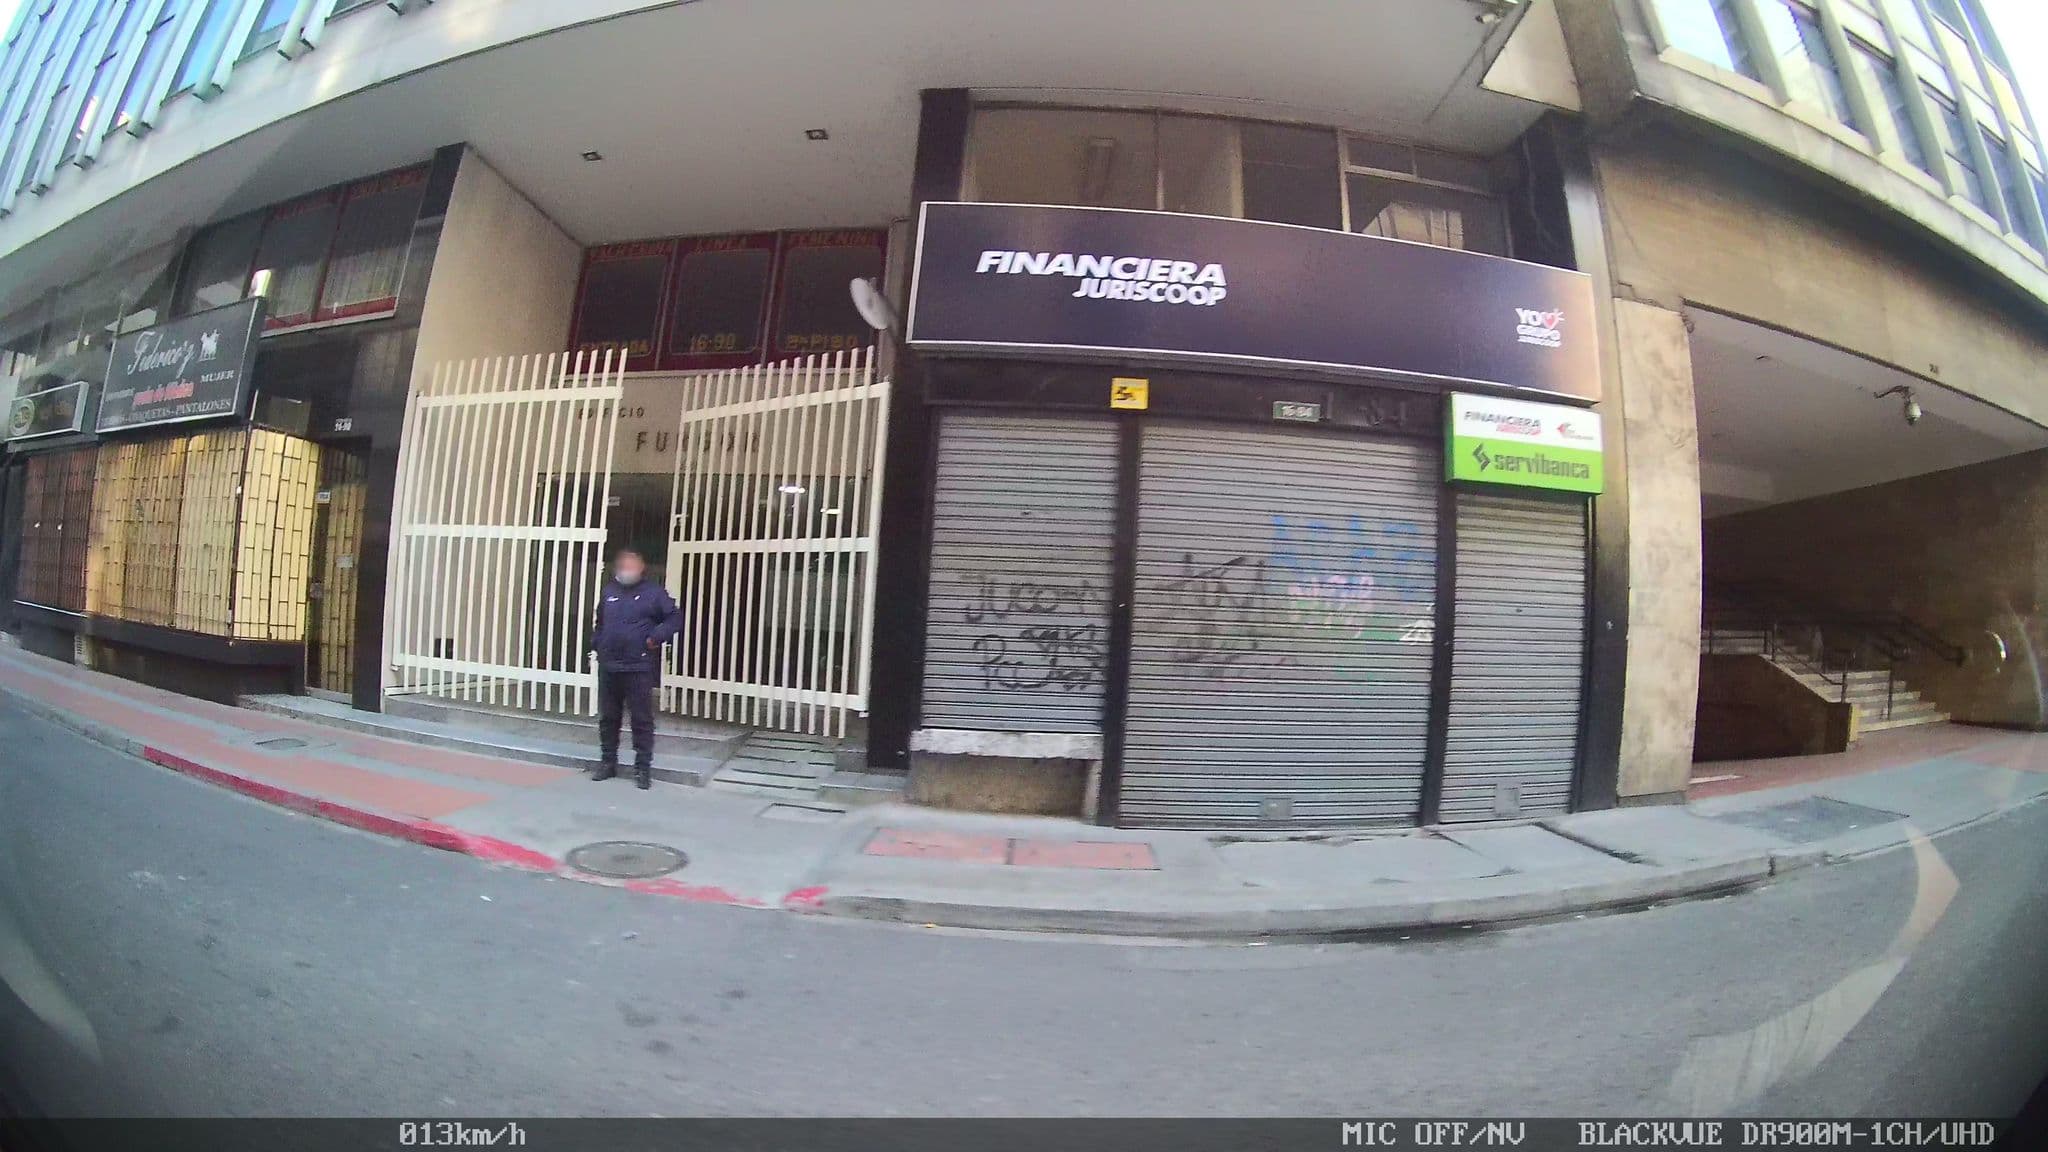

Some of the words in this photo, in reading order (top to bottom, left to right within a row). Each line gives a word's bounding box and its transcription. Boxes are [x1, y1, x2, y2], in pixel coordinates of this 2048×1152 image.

[976, 250, 1227, 286] FINANCIERA
[1072, 278, 1227, 306] JURISCOOP
[201, 370, 235, 383] MUJER
[1464, 411, 1542, 427] FINANCIERA
[1494, 452, 1591, 479] servibanca
